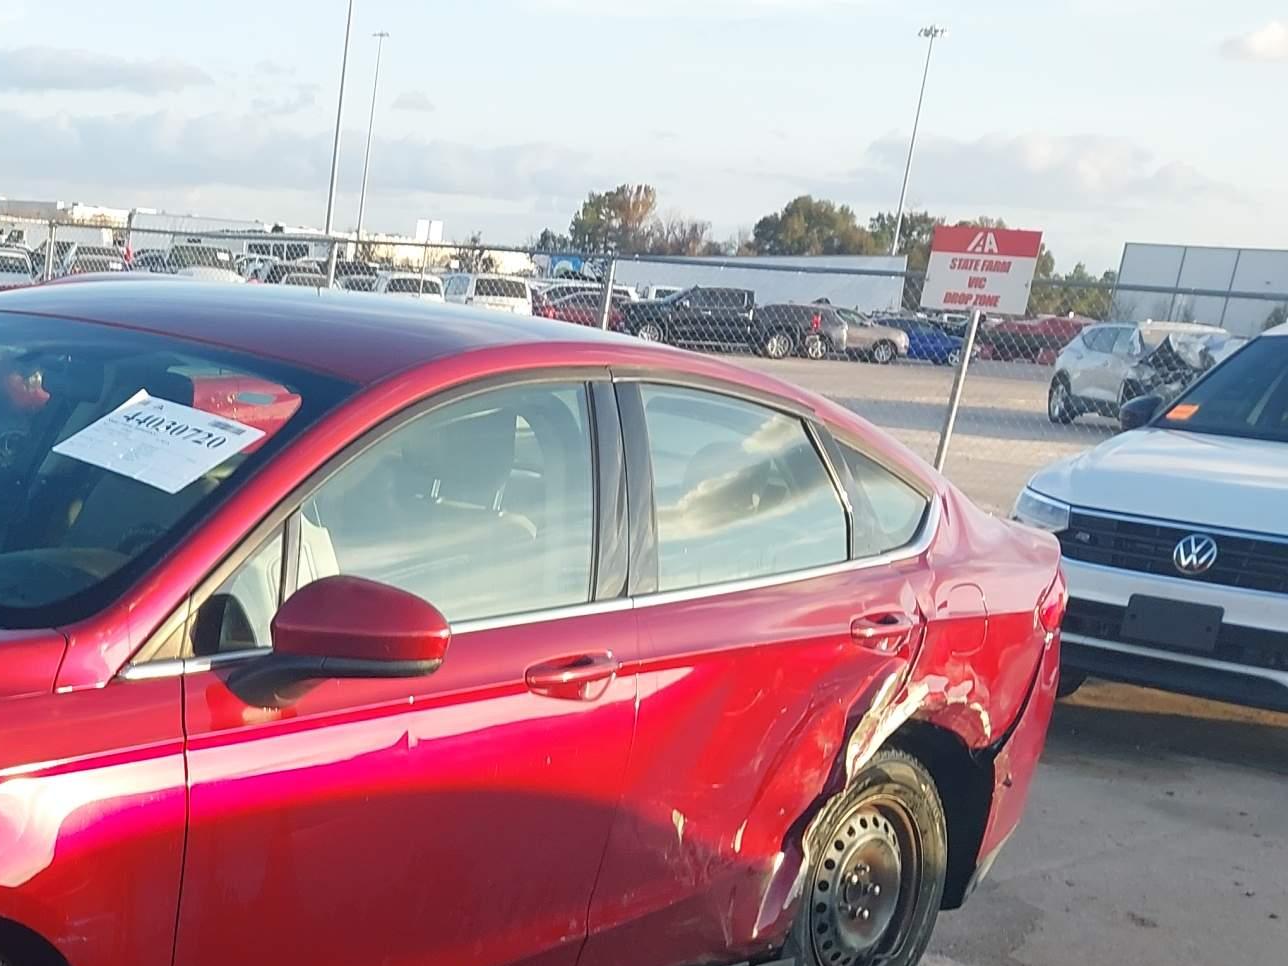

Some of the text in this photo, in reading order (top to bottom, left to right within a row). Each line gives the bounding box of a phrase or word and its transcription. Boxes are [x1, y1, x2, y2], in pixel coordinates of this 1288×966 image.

[949, 257, 1012, 273] STATE FARM
[967, 276, 987, 289] VIC
[943, 292, 1001, 307] DROP ZONE
[123, 410, 227, 449] 44030720
